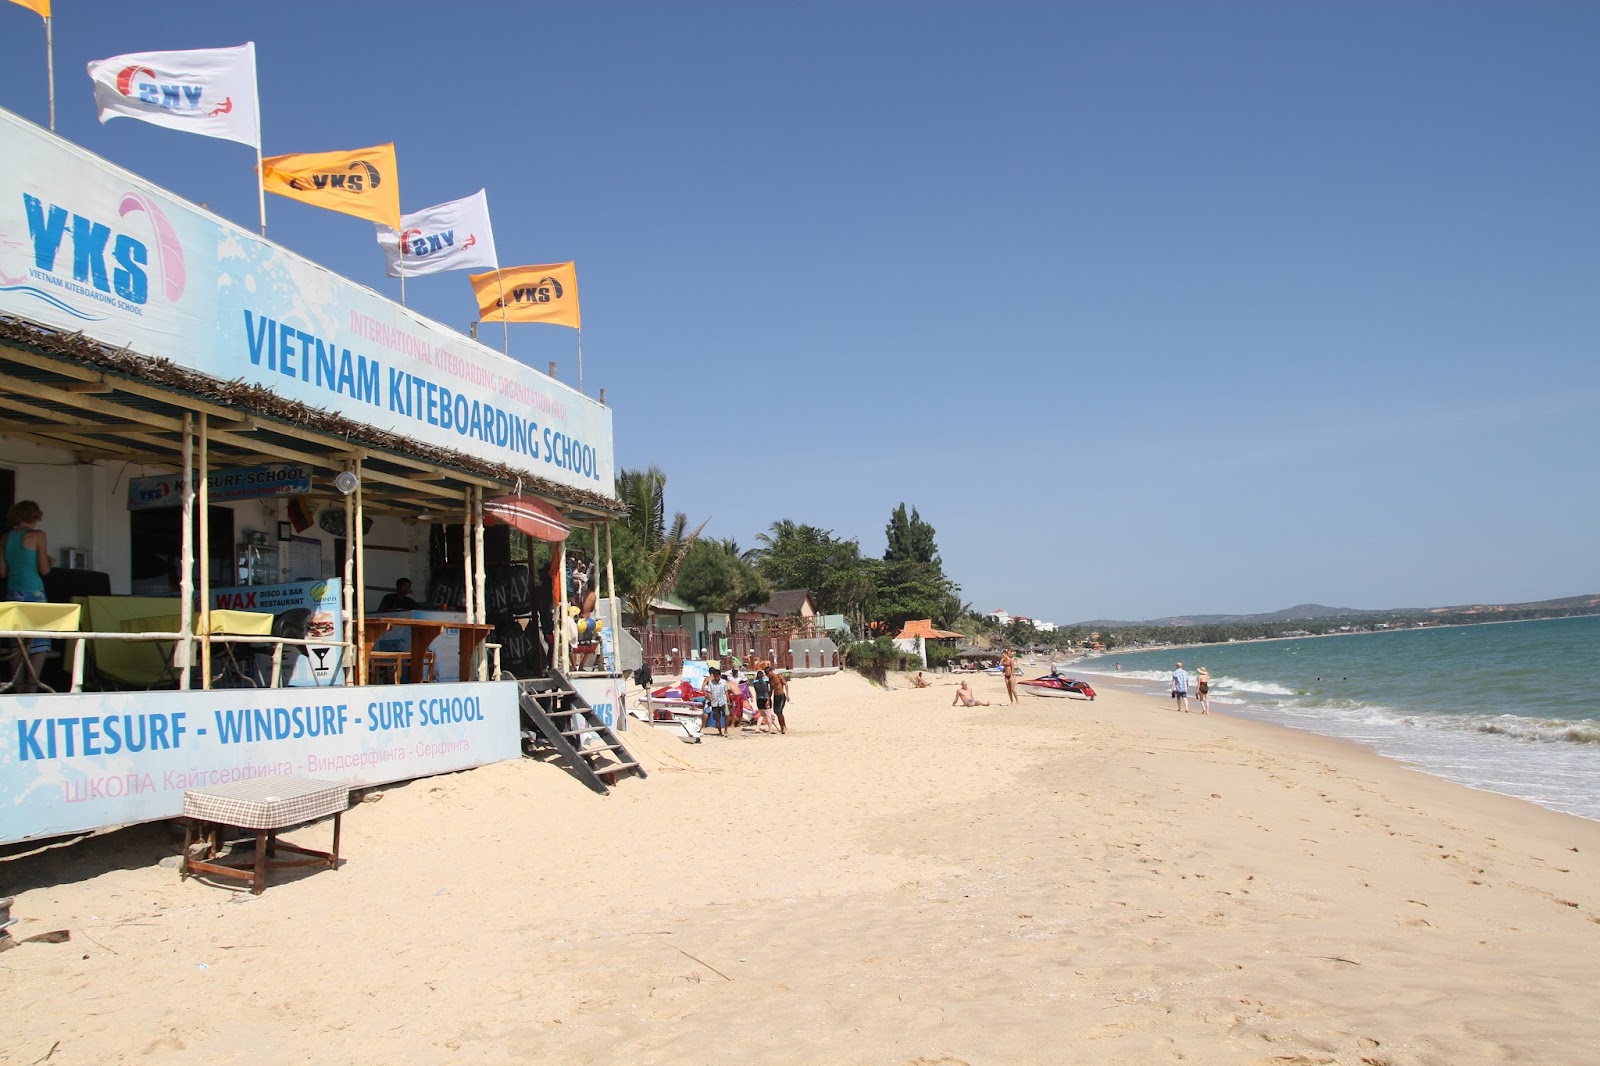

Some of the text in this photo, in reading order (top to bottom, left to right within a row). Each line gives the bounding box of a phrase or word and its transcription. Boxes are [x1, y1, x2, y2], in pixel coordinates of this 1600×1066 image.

[312, 174, 363, 191] VKS
[23, 192, 148, 305] VKS
[29, 268, 143, 316] VIETNAM KITEBOARDING SCHOOL
[513, 287, 551, 303] VKS
[350, 309, 432, 366] INTERNATIONAL
[434, 346, 497, 392] KITEBOARDING
[498, 375, 551, 415] ORGANIZATION
[244, 309, 600, 481] VIETNAM KITEBOARDING SCHOOL
[140, 489, 162, 500] VKS
[175, 468, 306, 491] KTSURF SCHOOL
[215, 592, 258, 609] WAX
[260, 590, 280, 598] DISCO
[289, 588, 303, 596] BAR
[260, 598, 305, 608] RESTAURANT
[17, 712, 187, 761] KITESURF
[215, 704, 348, 744] WINDSURF
[367, 700, 414, 732] SURF
[419, 696, 485, 727] SCHOOL
[64, 772, 156, 803] ШКОЛА
[163, 762, 293, 791] Кайтсерфинга
[307, 747, 406, 773] Виндсерфинга
[415, 738, 470, 760] Серфинга
